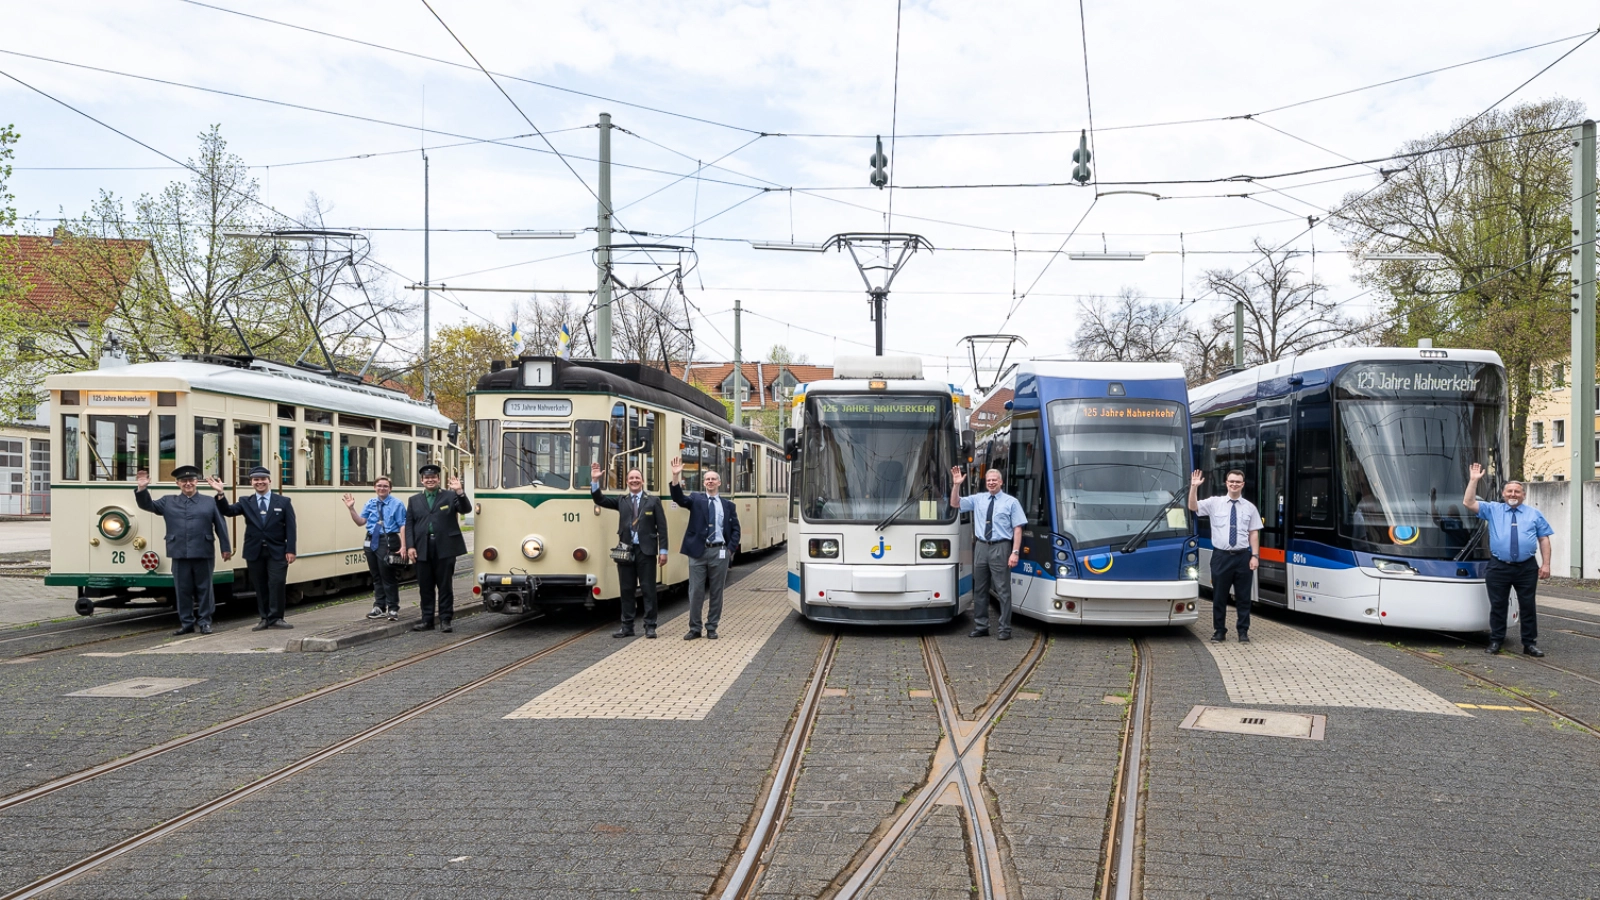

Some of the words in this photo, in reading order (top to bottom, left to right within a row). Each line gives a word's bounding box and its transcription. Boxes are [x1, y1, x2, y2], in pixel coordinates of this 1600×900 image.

[536, 367, 542, 383] 1
[1357, 372, 1375, 389] 125
[1378, 372, 1411, 390] Jahre
[1413, 373, 1480, 392] Nahverkehr
[92, 394, 102, 402] 125
[117, 395, 147, 403] Nahverkehr
[510, 403, 521, 411] 125
[521, 403, 537, 411] Jahre
[537, 403, 569, 412] Nahverkehr
[841, 404, 870, 413] JAHRE
[873, 404, 936, 413] NAHVERKEHR
[1083, 407, 1098, 417] 125
[1100, 407, 1125, 418] Jahre
[1126, 408, 1175, 418] Nahverkehr
[562, 512, 580, 522] 101
[111, 550, 126, 564] 26
